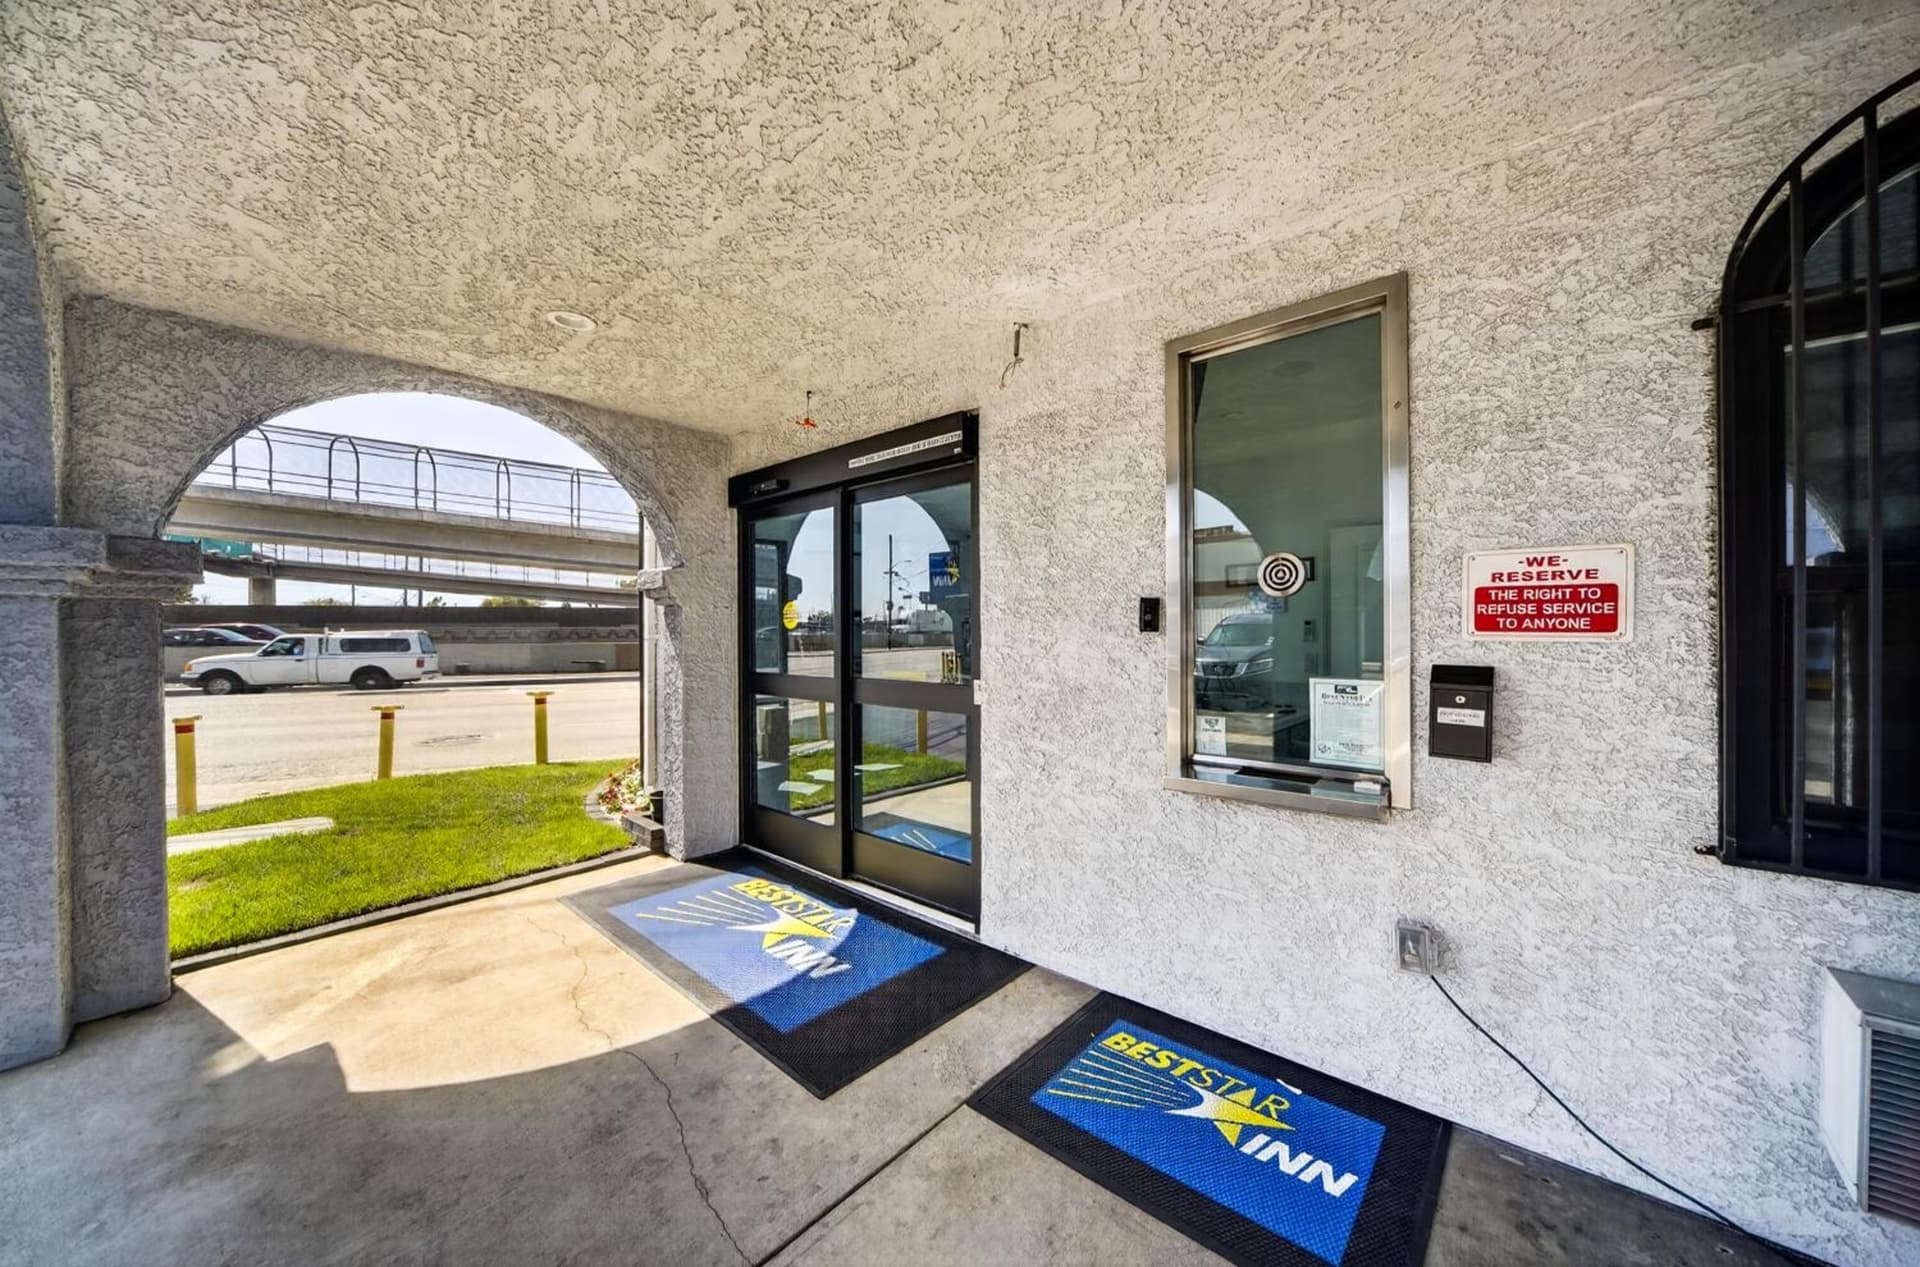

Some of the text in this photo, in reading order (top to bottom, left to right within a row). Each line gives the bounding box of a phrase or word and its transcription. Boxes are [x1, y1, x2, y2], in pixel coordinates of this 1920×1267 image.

[1518, 555, 1569, 567] -WE-
[1490, 568, 1599, 583] RESERVE
[1488, 587, 1601, 601] THE RIGHT TO
[1476, 602, 1616, 615] REFUSE SERVICE
[1496, 617, 1592, 630] TO ANYONE
[764, 939, 852, 979] INN
[1239, 1133, 1359, 1198] INN
